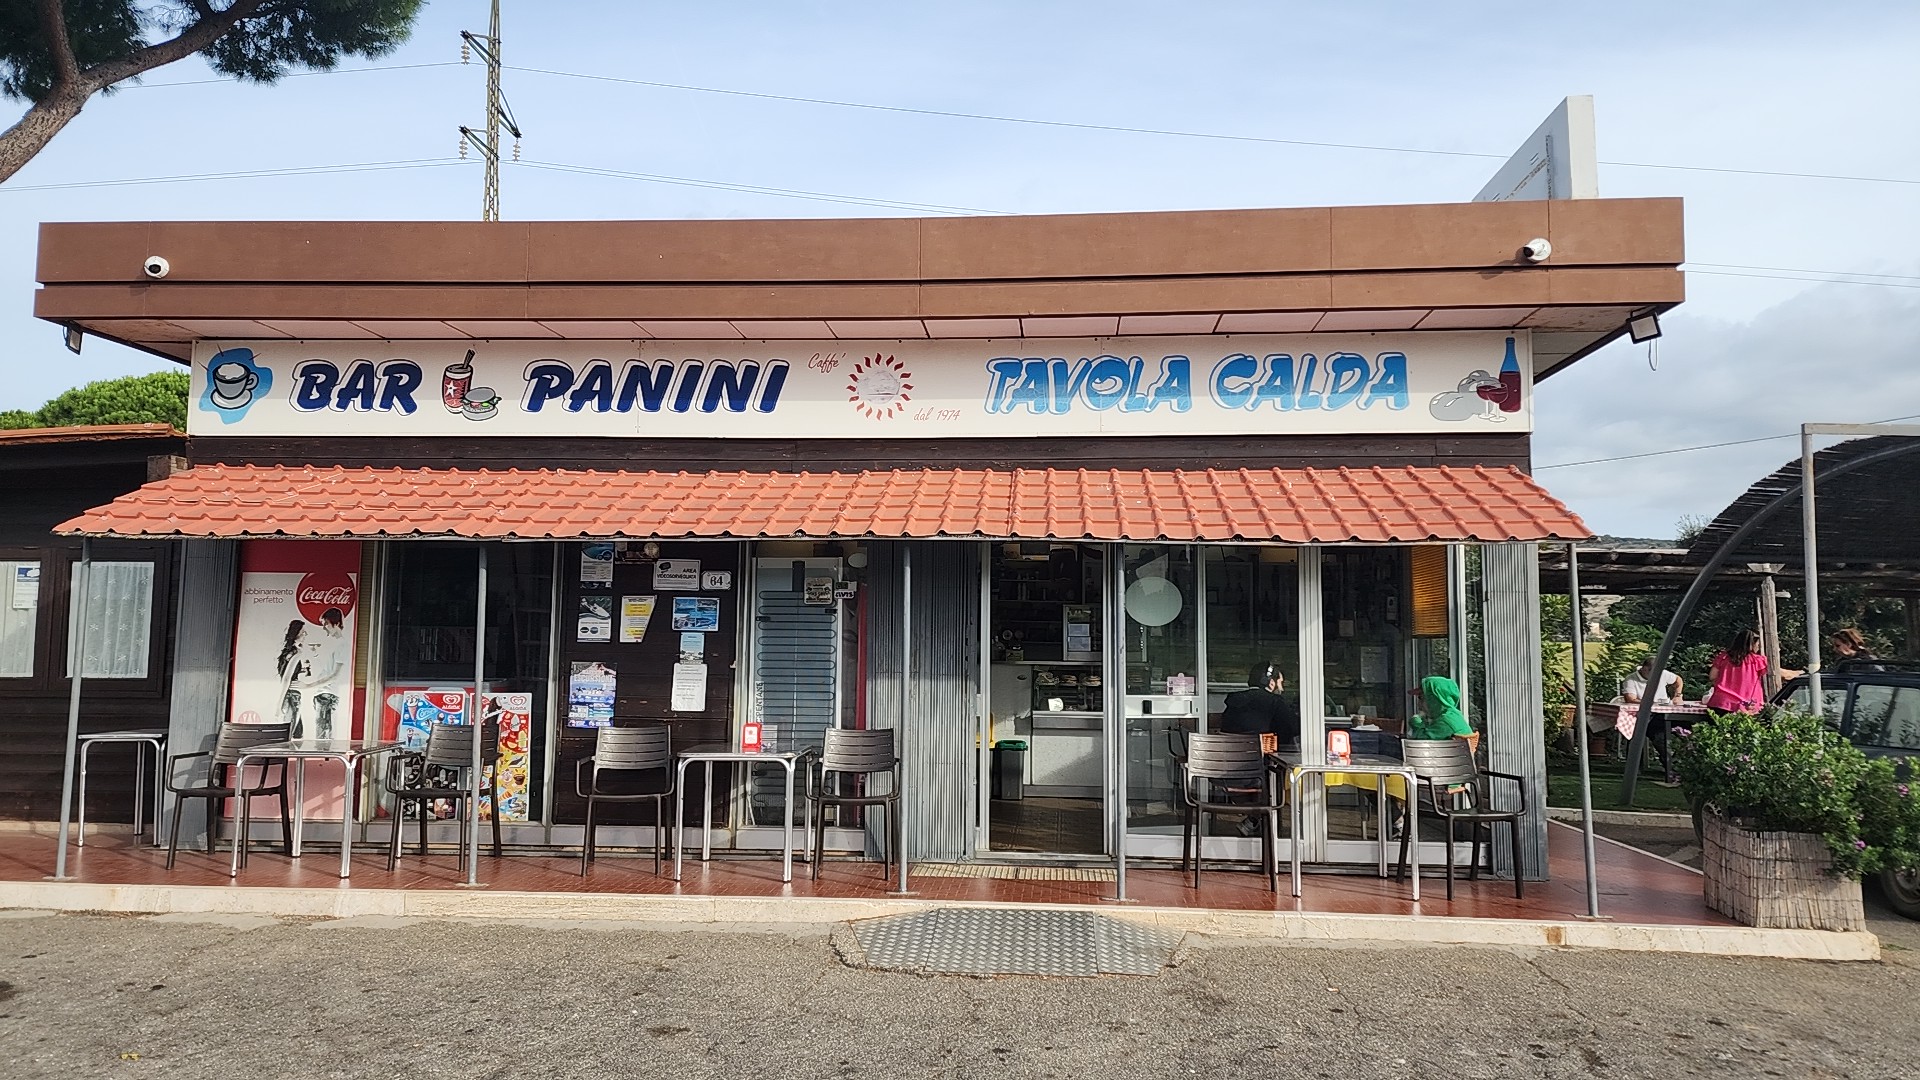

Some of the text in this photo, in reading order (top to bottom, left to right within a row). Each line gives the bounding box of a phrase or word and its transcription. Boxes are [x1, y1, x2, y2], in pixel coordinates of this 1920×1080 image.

[289, 358, 422, 415] BAR
[521, 358, 790, 414] PANINI
[984, 352, 1410, 415] TAVOLA CALDA
[913, 407, 961, 421] dal 1974
[244, 587, 294, 596] abbinamento
[253, 596, 284, 604] perfetto
[300, 586, 353, 605] Coca-Cola
